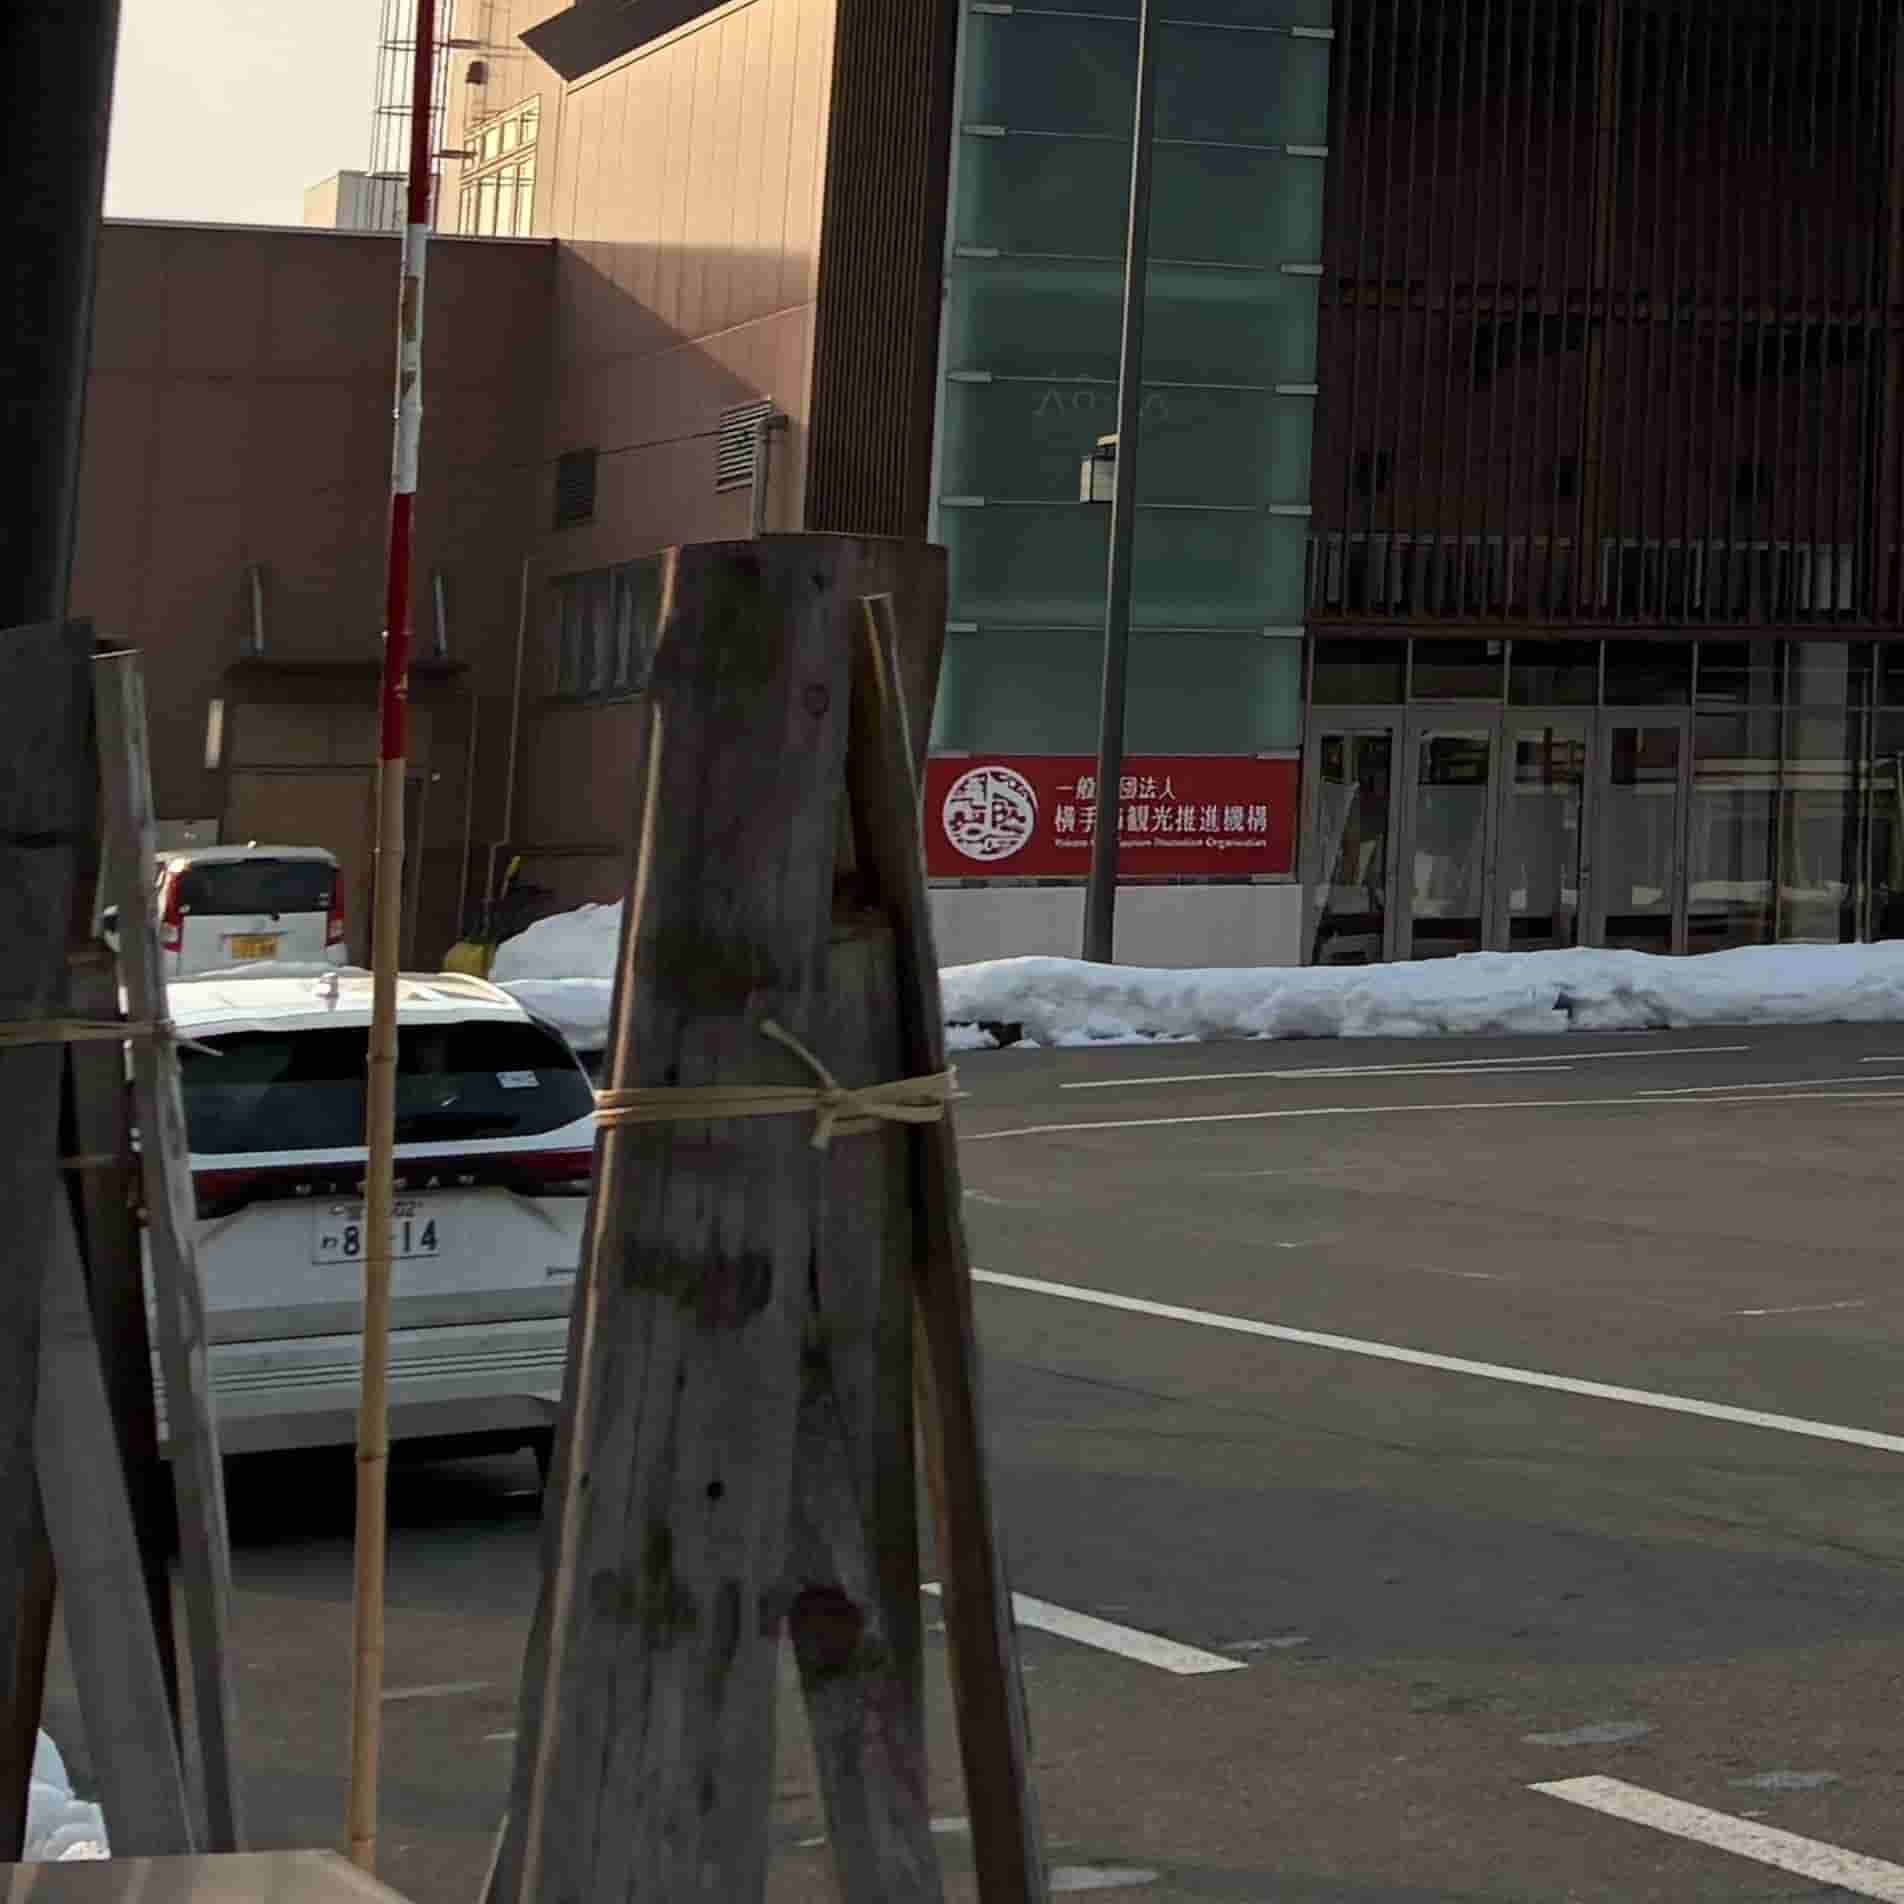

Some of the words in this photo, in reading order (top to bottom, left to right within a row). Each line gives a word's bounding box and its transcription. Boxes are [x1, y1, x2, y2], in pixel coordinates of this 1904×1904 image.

[1055, 776, 1177, 800] 一般団法人
[295, 1174, 476, 1195] NISAN
[343, 1219, 438, 1256] 8-14
